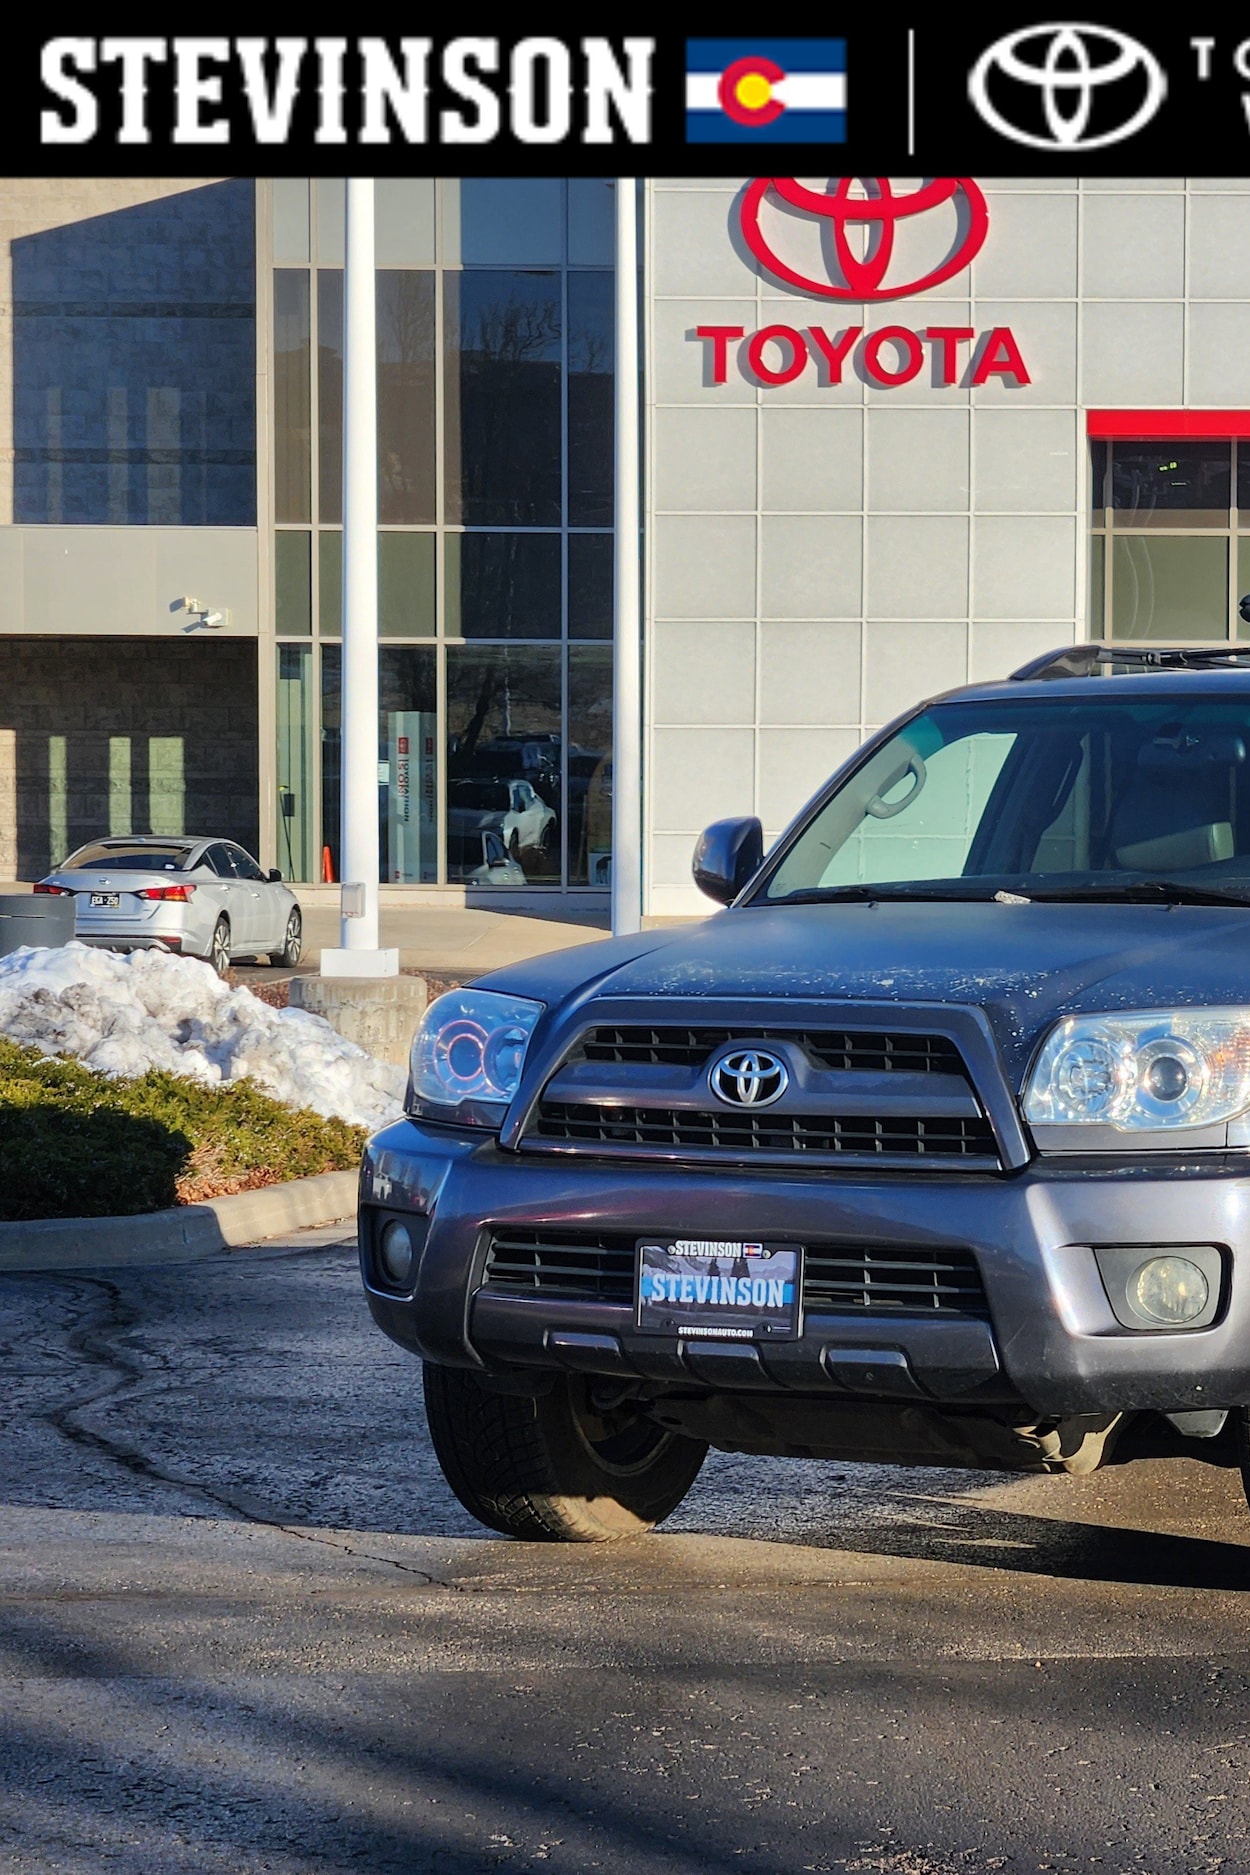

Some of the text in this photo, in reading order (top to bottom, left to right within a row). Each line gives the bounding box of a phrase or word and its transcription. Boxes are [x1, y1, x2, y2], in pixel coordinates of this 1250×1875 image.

[696, 324, 1031, 387] TOYOTA
[675, 1240, 742, 1258] STEVINSON
[651, 1273, 785, 1308] STEVINSON
[678, 1326, 754, 1338] STEVINSONAUTO.COM
